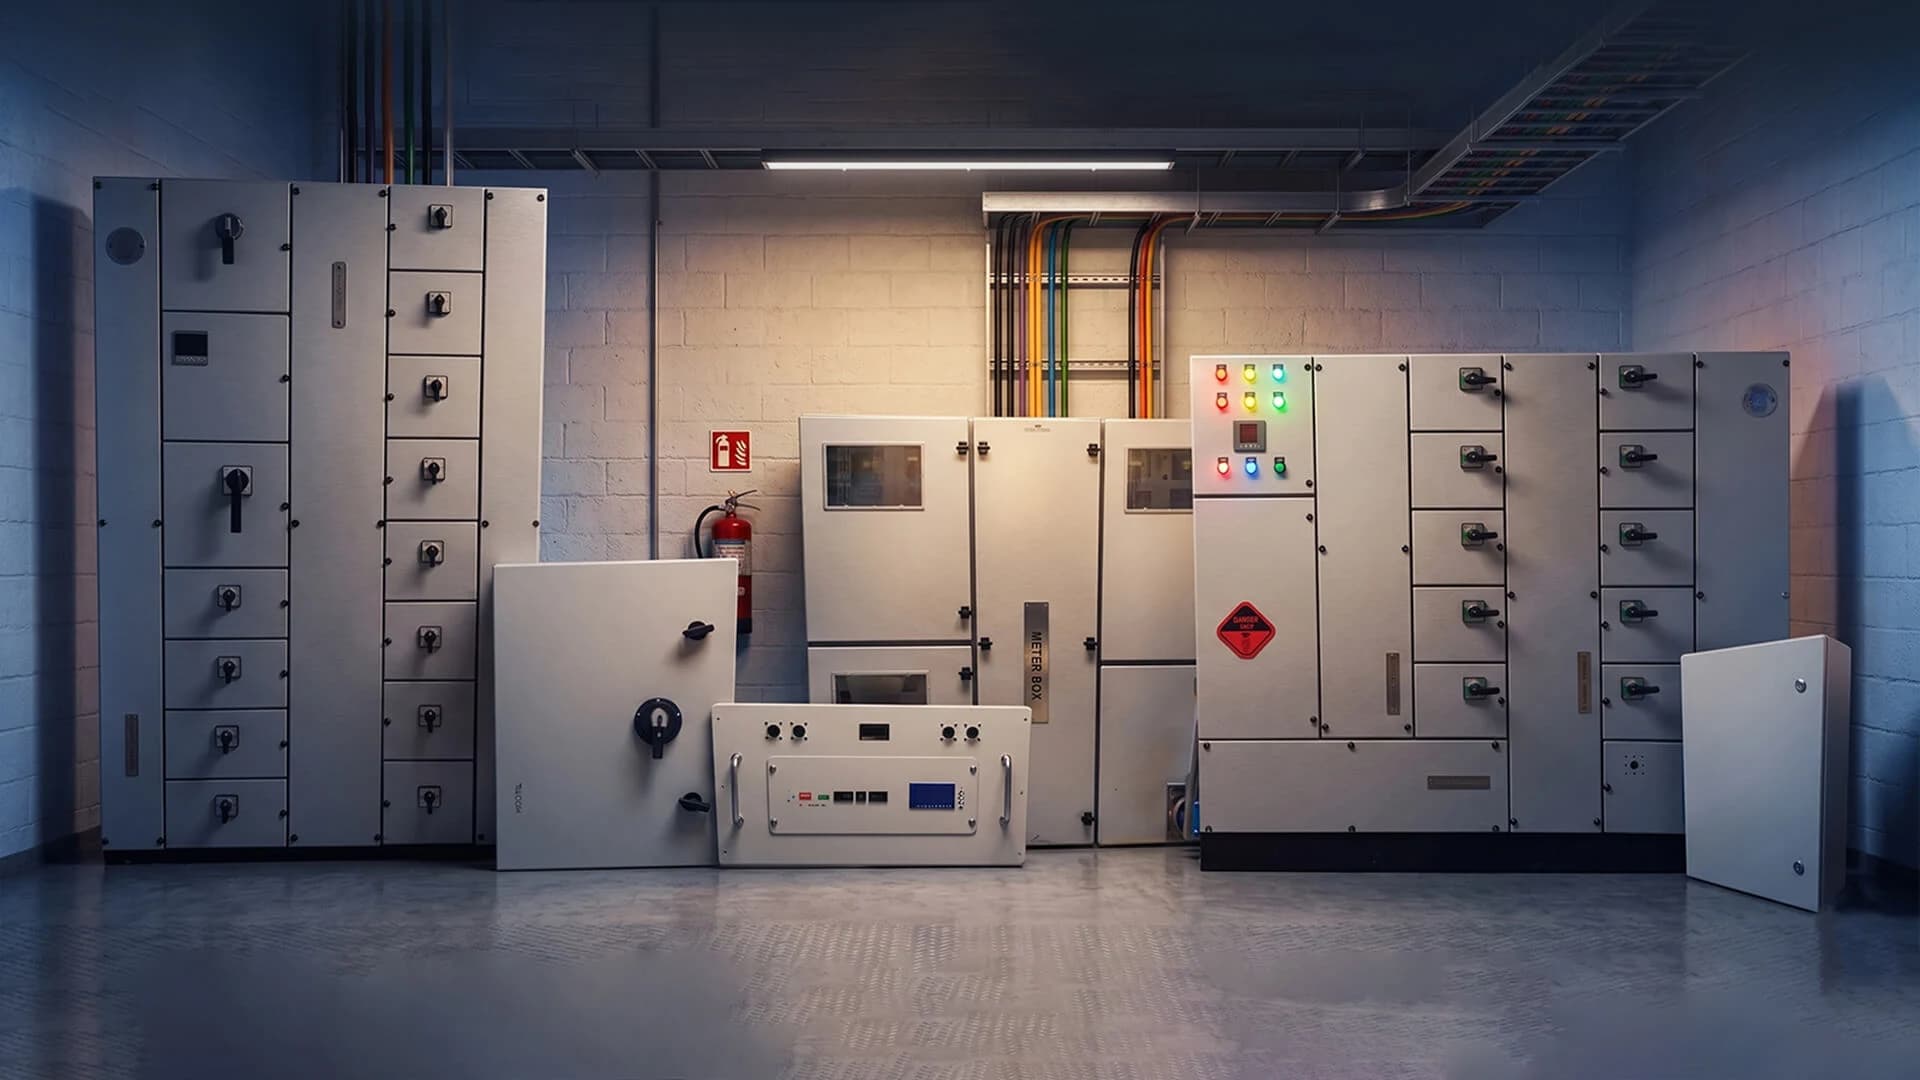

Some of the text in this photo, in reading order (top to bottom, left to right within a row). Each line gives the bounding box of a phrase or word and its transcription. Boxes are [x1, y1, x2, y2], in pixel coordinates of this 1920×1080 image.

[1232, 615, 1259, 624] DANGER
[1031, 631, 1042, 700] METER BOX
